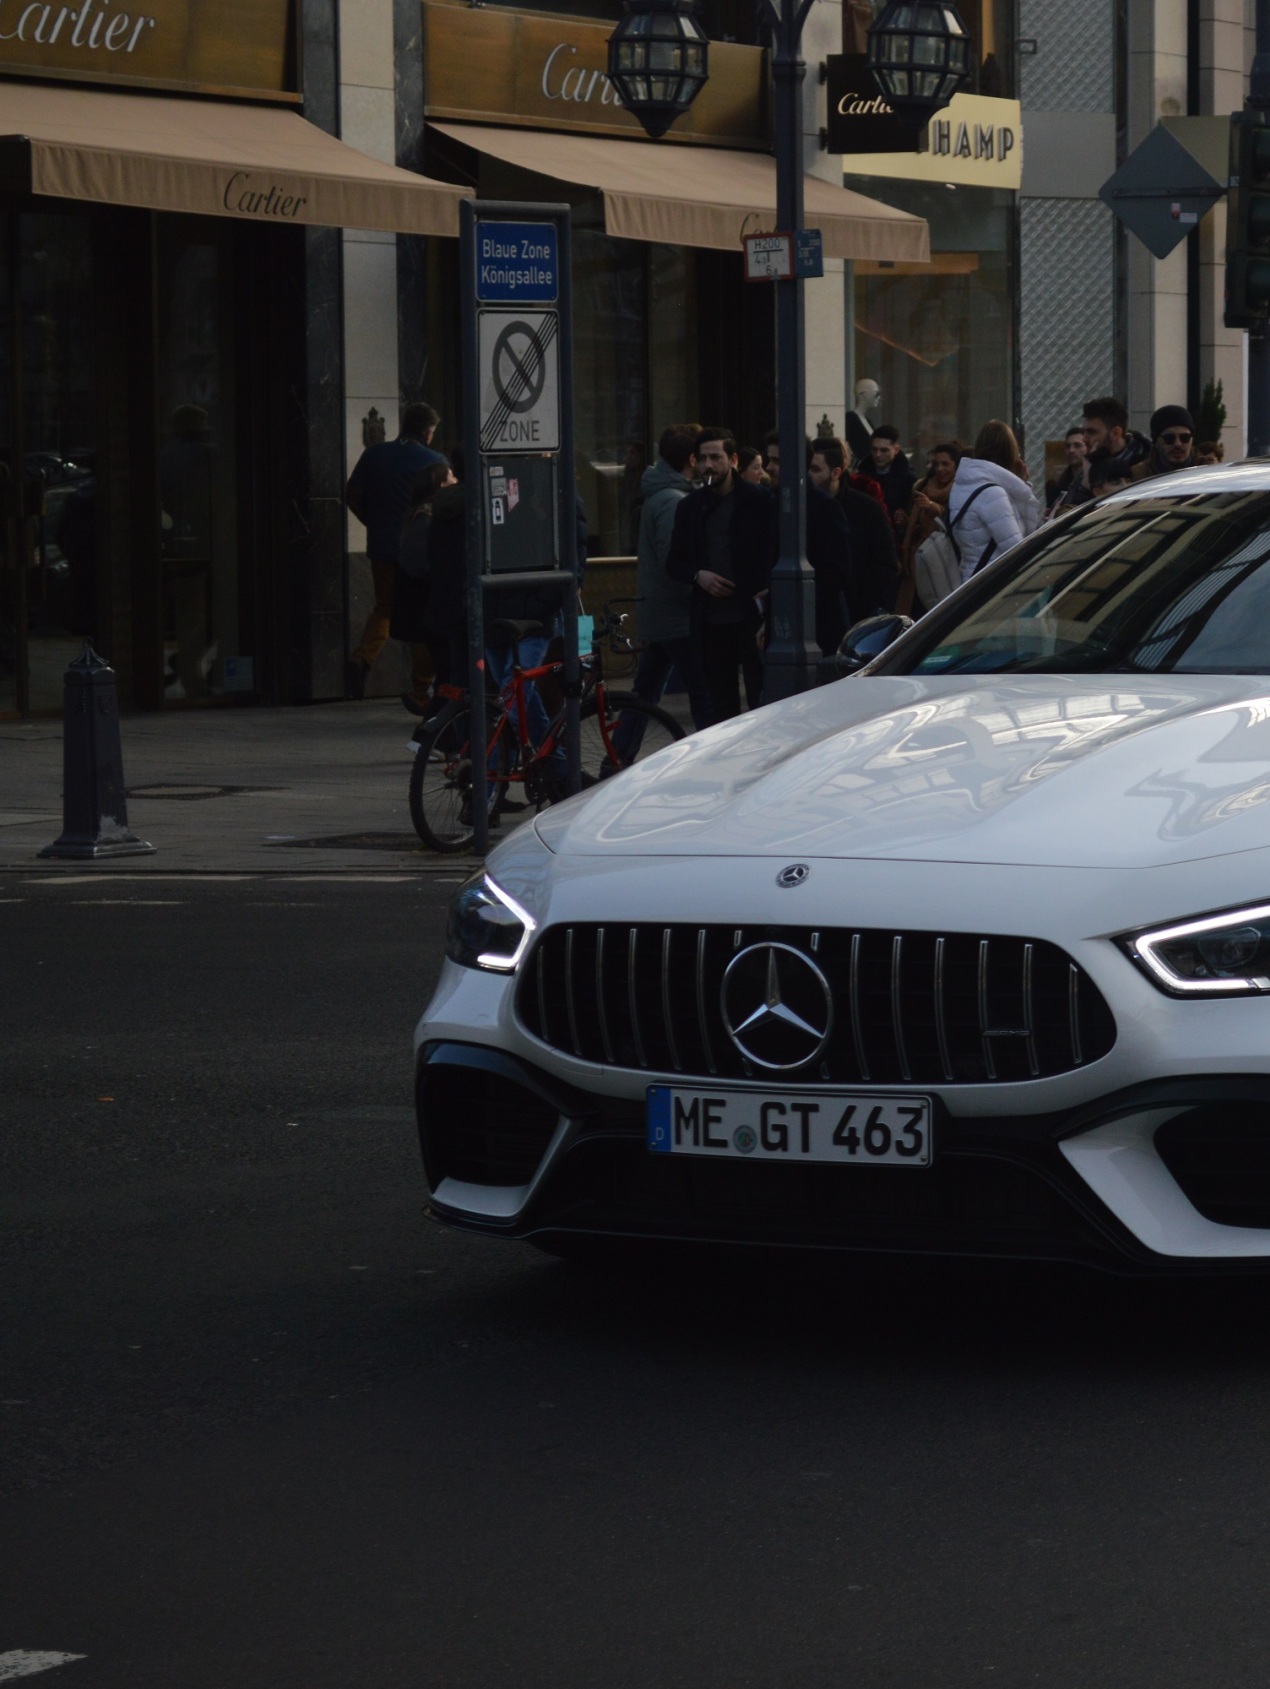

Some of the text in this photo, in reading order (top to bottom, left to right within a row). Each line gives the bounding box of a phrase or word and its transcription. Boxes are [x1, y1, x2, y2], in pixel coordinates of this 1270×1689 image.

[223, 171, 307, 217] Cartier
[482, 239, 551, 259] Blaue Zone
[481, 265, 553, 289] Königsallee
[499, 420, 540, 442] ZONE
[674, 1096, 923, 1157] ME GT 463
